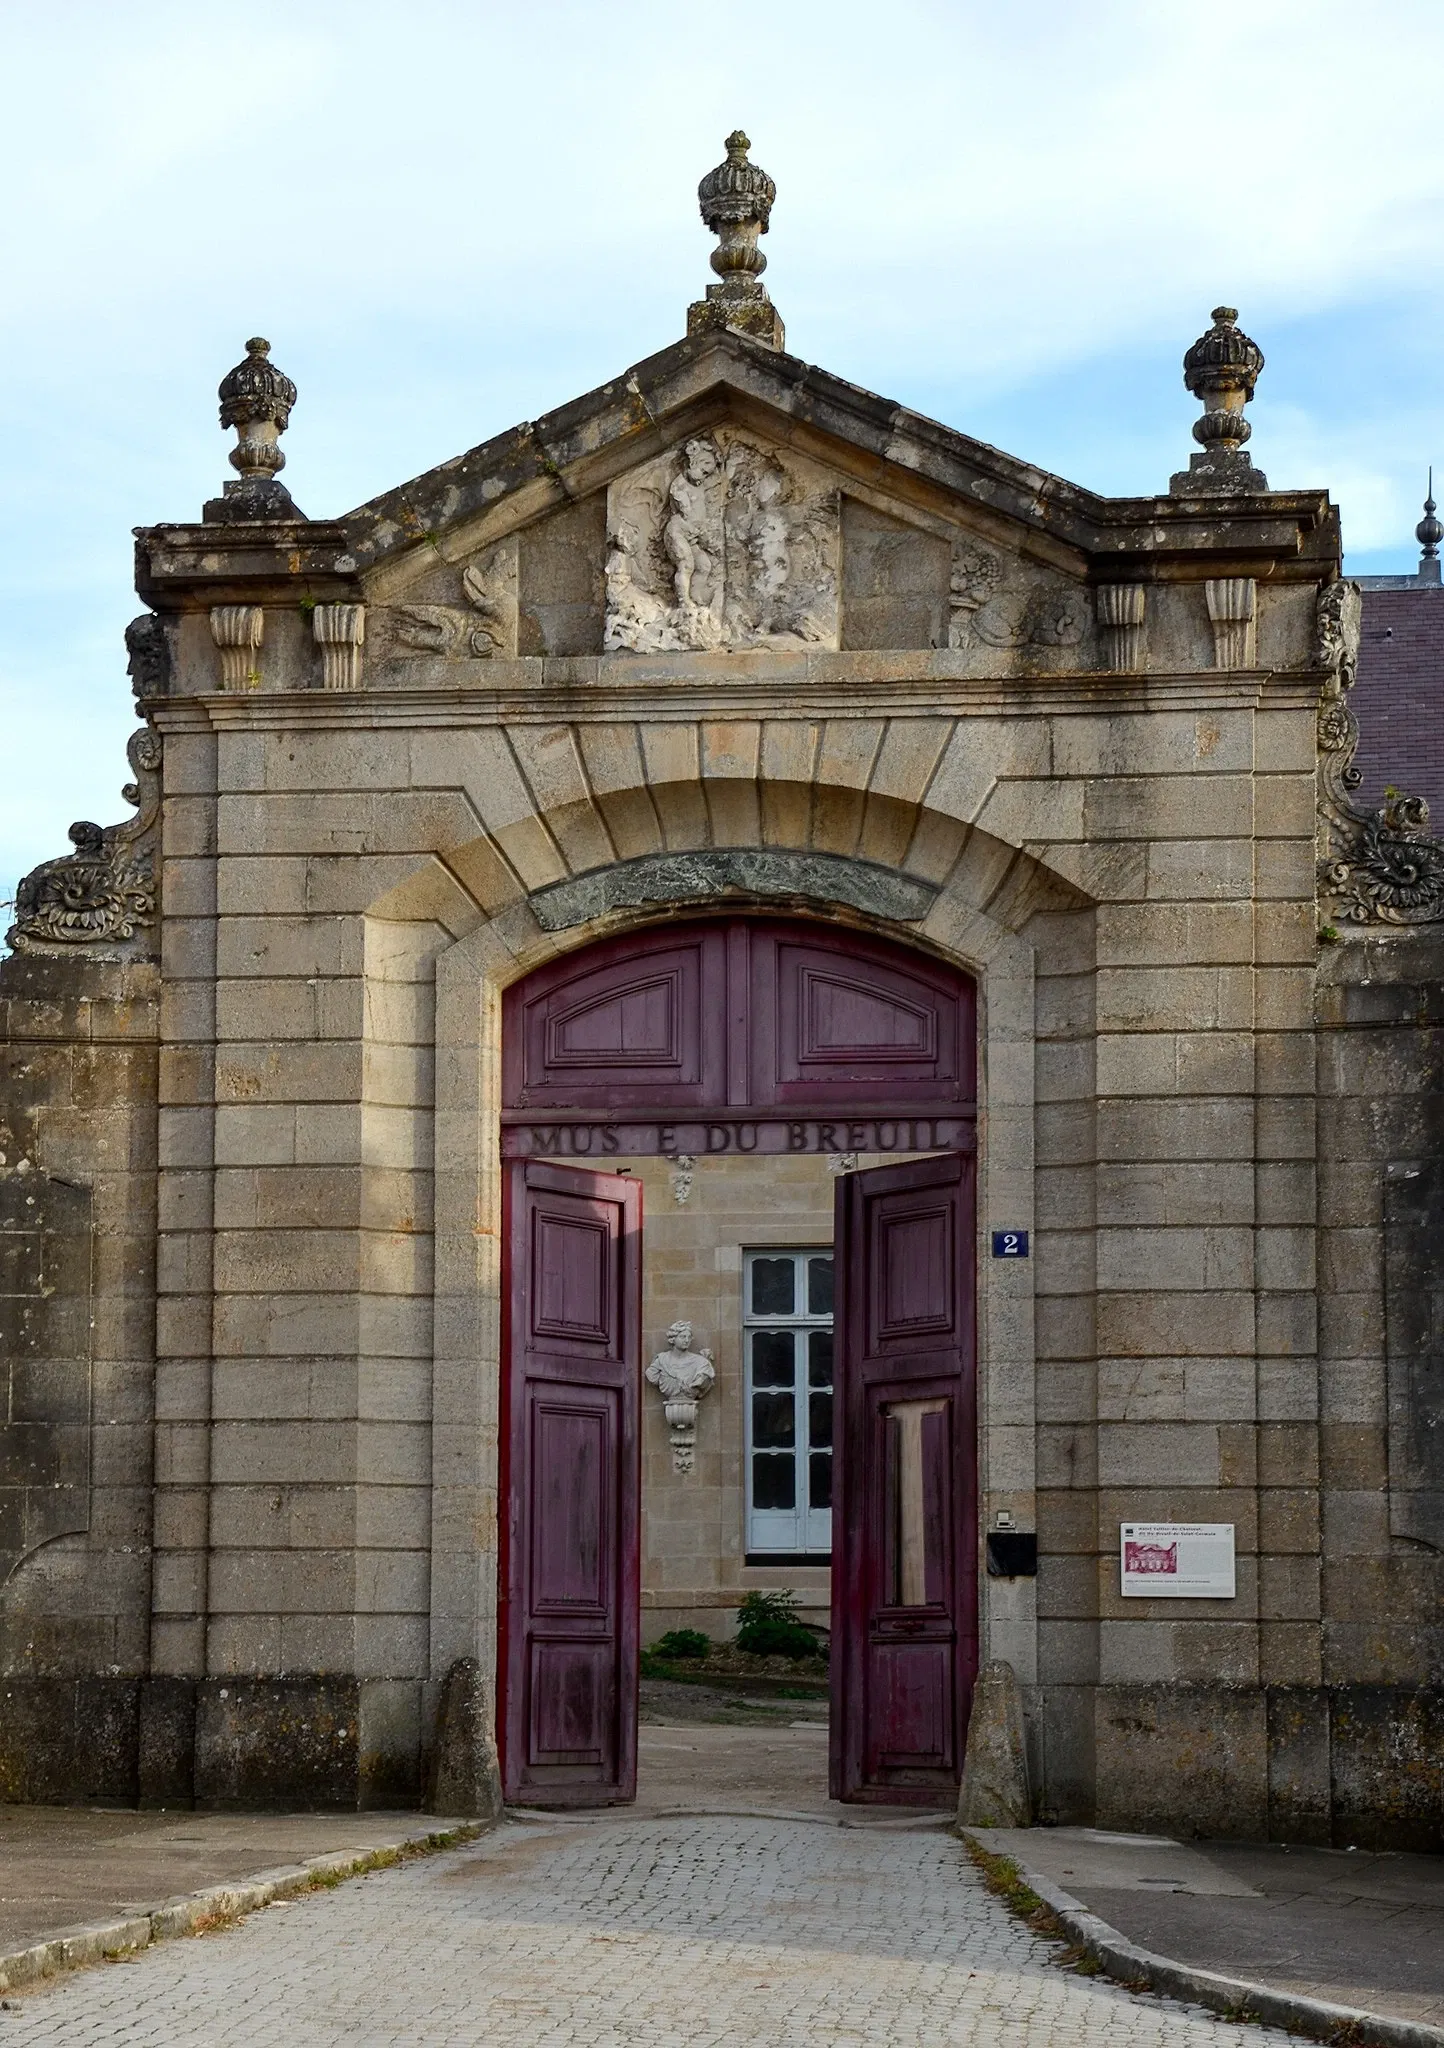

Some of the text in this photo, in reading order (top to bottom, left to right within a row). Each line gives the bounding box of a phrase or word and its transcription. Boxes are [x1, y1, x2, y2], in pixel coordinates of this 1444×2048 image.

[704, 1123, 758, 1152] DU
[786, 1120, 951, 1151] BREUIL
[1003, 1234, 1018, 1254] 2
